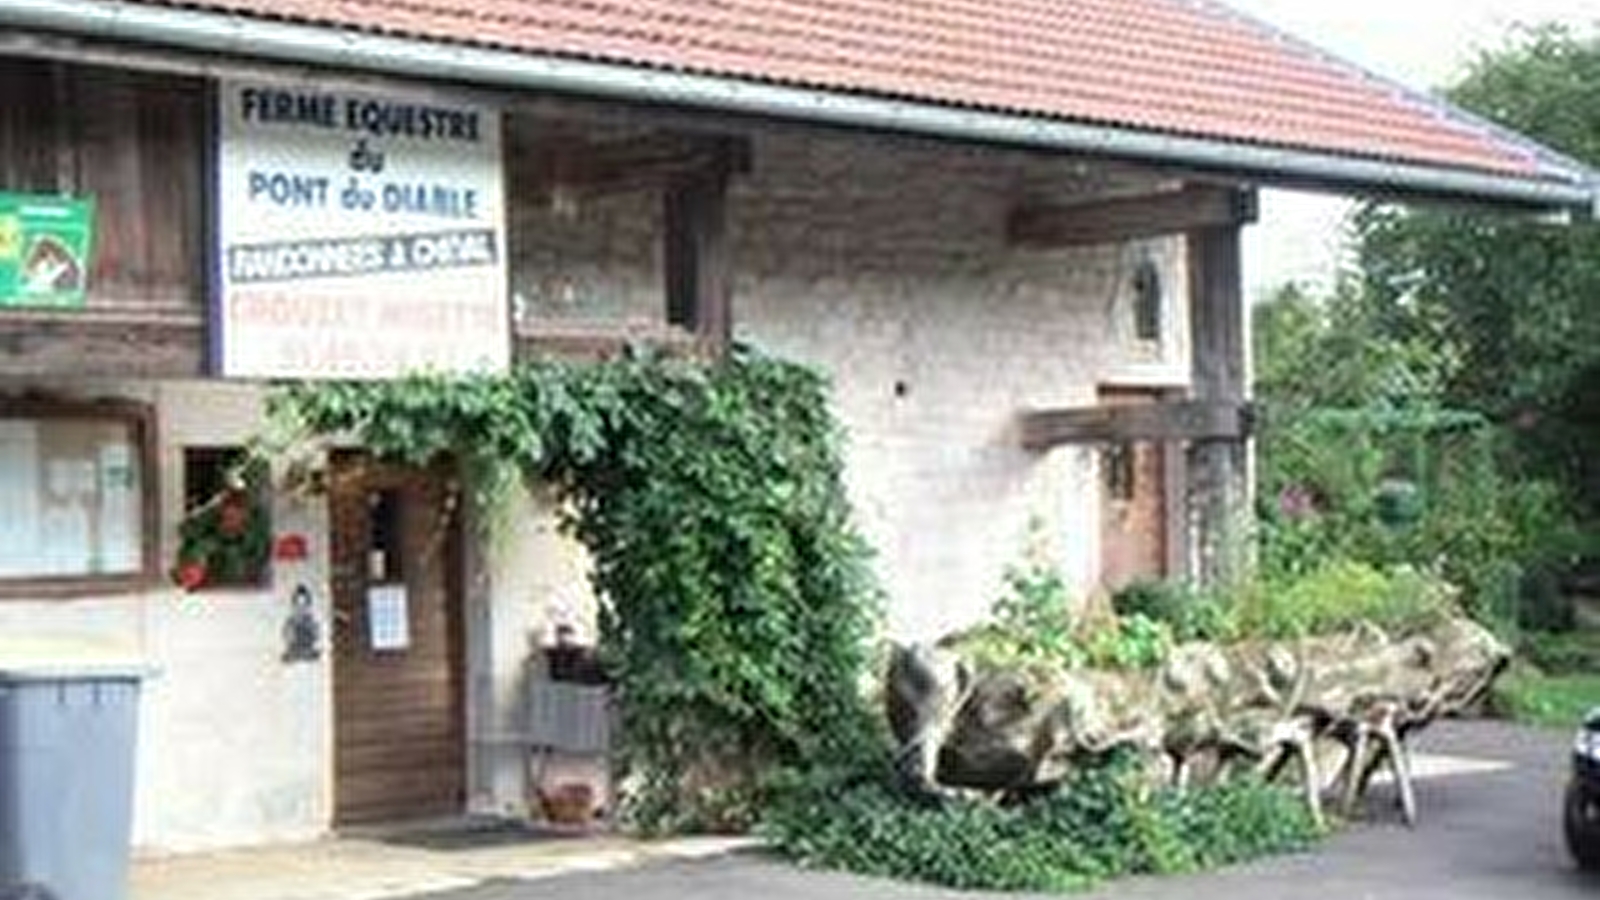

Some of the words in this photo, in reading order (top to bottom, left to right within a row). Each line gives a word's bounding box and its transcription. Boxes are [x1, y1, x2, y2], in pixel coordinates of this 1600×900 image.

[241, 87, 337, 128] FERME
[346, 99, 480, 141] EQUESTRE
[350, 140, 384, 174] du
[250, 173, 330, 206] PONT
[341, 176, 376, 211] du
[382, 183, 478, 219] DIABLE
